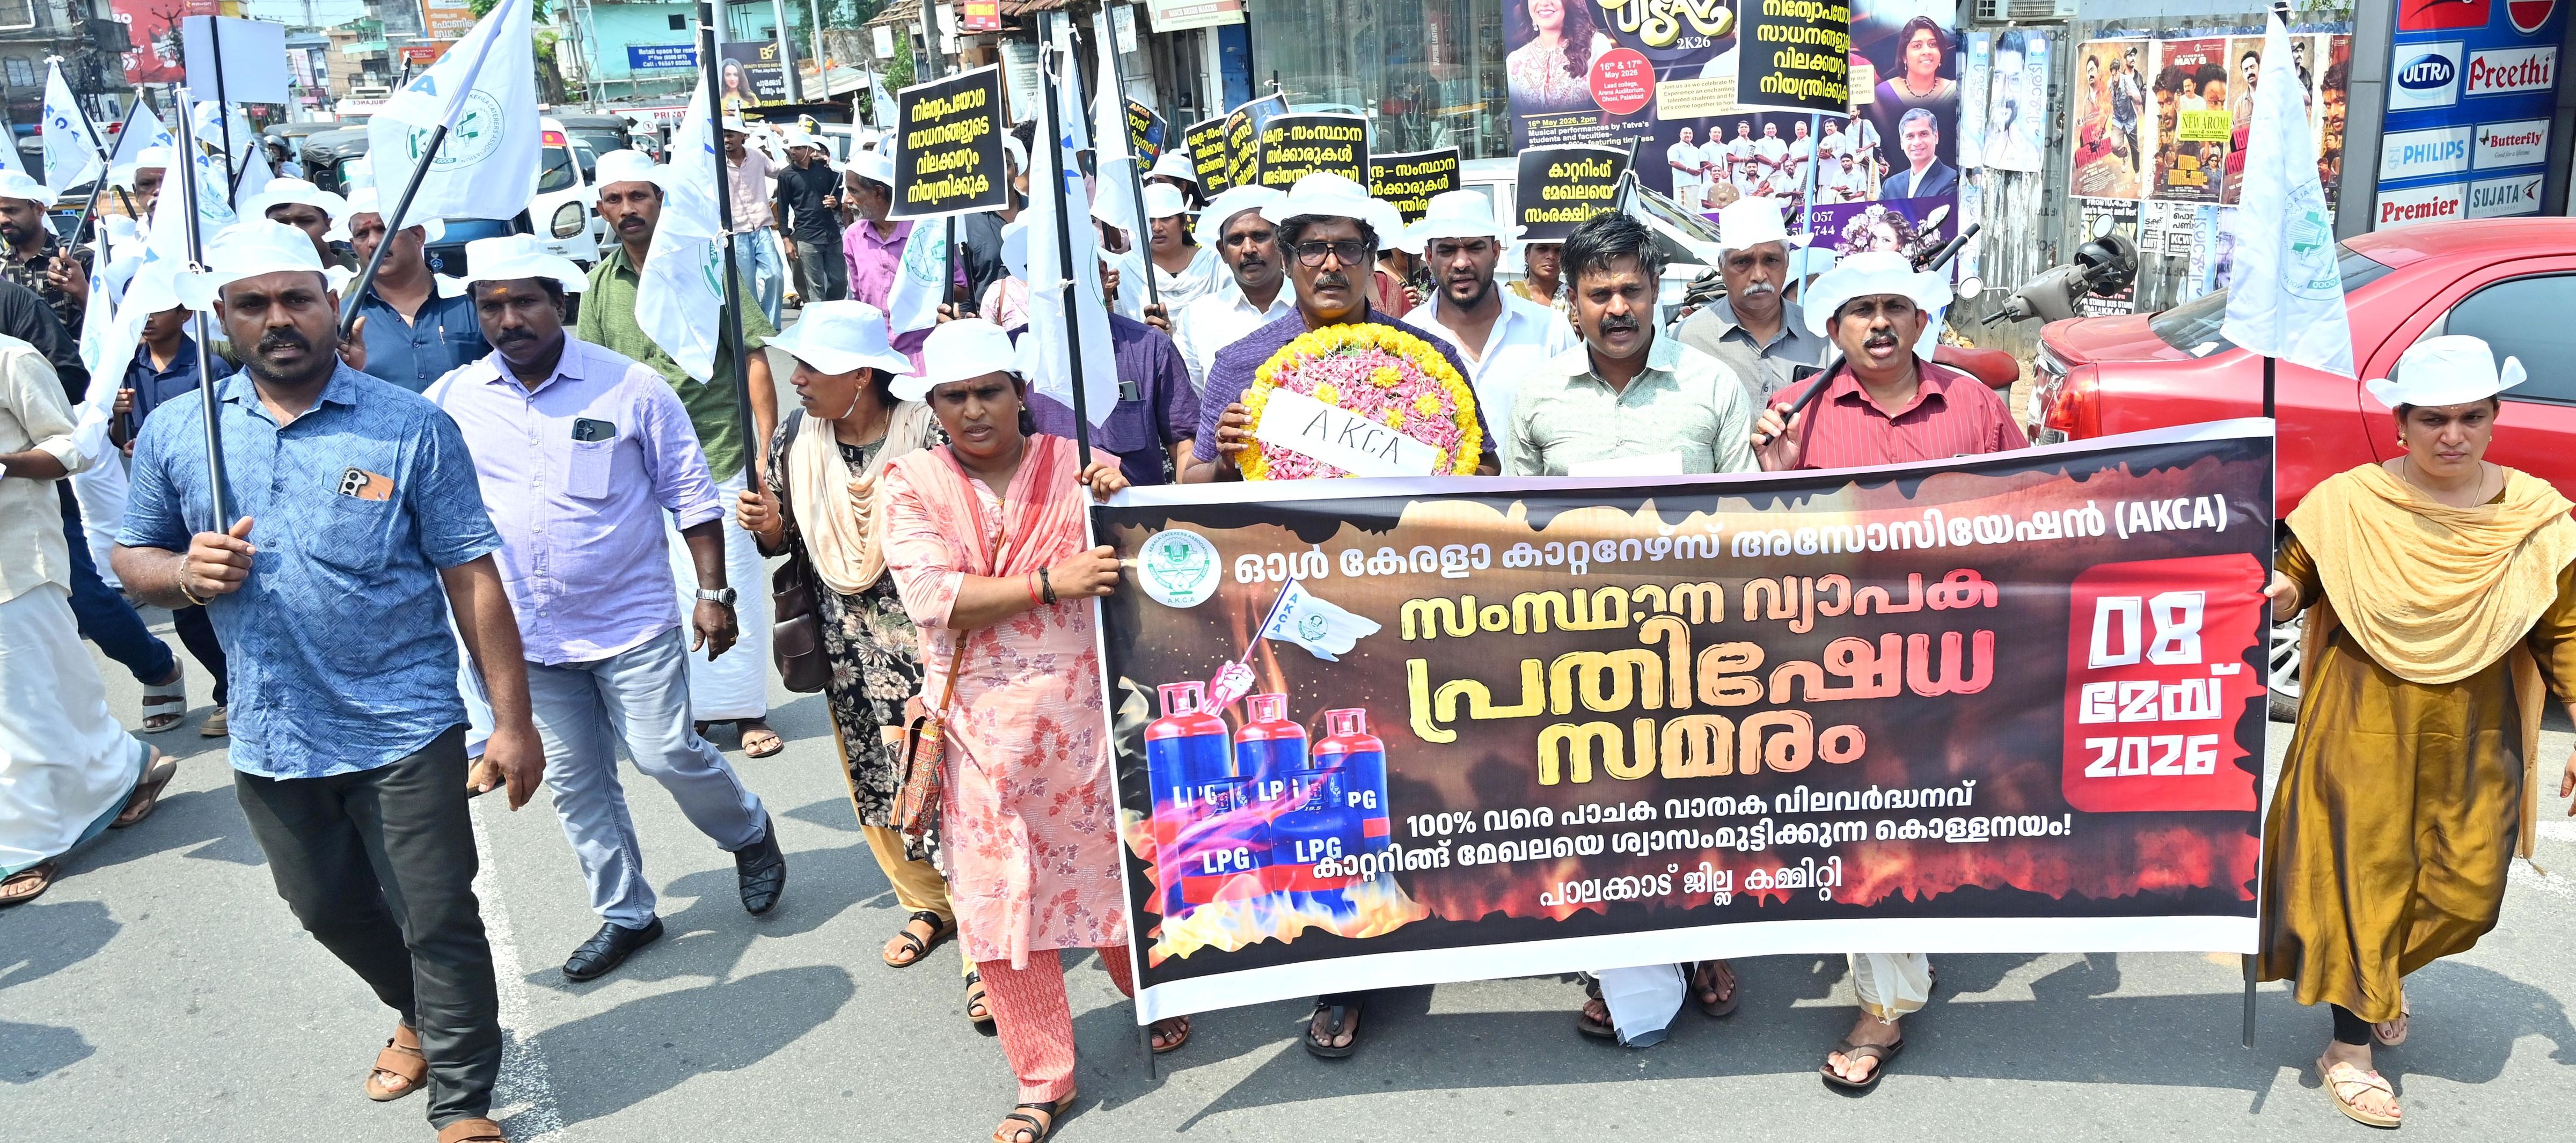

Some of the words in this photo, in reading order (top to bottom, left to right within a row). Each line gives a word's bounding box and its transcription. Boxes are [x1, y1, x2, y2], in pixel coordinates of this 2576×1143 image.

[1198, 4, 1218, 13] MAKERS
[1677, 36, 1711, 50] 2K26
[1600, 62, 1615, 71] 16th
[1618, 61, 1624, 69] &
[1627, 60, 1642, 69] 17th
[1773, 46, 1846, 80] വിലക്കയറ്റം
[2175, 57, 2197, 65] MAY
[2198, 56, 2207, 64] 8
[2403, 63, 2450, 83] ULTRA
[2468, 54, 2549, 91] Preethi
[654, 109, 687, 119] PRIAT
[912, 87, 985, 122] നിത്യോപയോഗ
[908, 115, 990, 150] സാധനങ്ങളുടെ
[1528, 129, 1557, 137] Musical
[1558, 124, 1609, 136] performances
[1611, 123, 1620, 131] by
[1580, 116, 1597, 124] 2pm
[2182, 116, 2200, 129] NEW
[2201, 116, 2228, 129] AROMA
[1528, 136, 1561, 144] students
[2403, 140, 2464, 164] PHILIPS
[2490, 131, 2543, 148] Butterfly
[916, 147, 979, 175] വിലക്കയറ്റം
[1267, 144, 1352, 165] സർക്കാരുകൾ
[1548, 158, 1613, 183] കാറ്ററിംഗ്
[908, 173, 990, 206] നിയന്ത്രിക്കുക
[1542, 185, 1613, 200] മേഖലയെ
[1812, 211, 1834, 223] 057
[2381, 196, 2458, 223] Premier
[2473, 185, 2519, 208] SUJATA
[1814, 225, 1835, 236] 744
[2171, 234, 2192, 245] KCW
[2118, 301, 2133, 309] STAND
[1301, 408, 1399, 465] AKCA
[1150, 537, 1162, 552] KERALA
[1188, 534, 1209, 559] ASSOCIATION
[1234, 544, 1329, 584] ഓൾ
[1340, 543, 1491, 578] കേരളാ
[1730, 500, 2106, 558] അസോസിയേഷൻ
[2114, 494, 2227, 540] (AKCA)
[1399, 580, 1725, 643] സംസ്ഥാന
[1741, 569, 2000, 635] വ്യാപക
[2087, 590, 2206, 670] 08
[1404, 613, 1995, 744] പ്രതിഷേധ
[2078, 663, 2242, 724] മേയ്
[1536, 708, 1867, 787] സമരം
[2084, 734, 2219, 778] 2026
[1406, 811, 1477, 838] 100%
[1483, 805, 1554, 831] വരെ
[1561, 800, 1657, 826] പാചക
[1664, 794, 1768, 819] വാതക
[1775, 780, 1977, 814] വിലവർദ്ധനവ്
[1203, 846, 1250, 874] LPG
[1295, 836, 1342, 863] LPG
[1312, 838, 1452, 883] കാറ്ററിങ്ങ്
[1457, 833, 1605, 867] മേഖലയെ
[1611, 817, 1868, 859] ശ്വാസംമുട്ടിക്കുന്ന
[1539, 862, 1679, 907] പാലക്കാട്
[1683, 861, 1733, 906] ജില്ല
[1744, 855, 1843, 902] കമ്മിറ്റി
